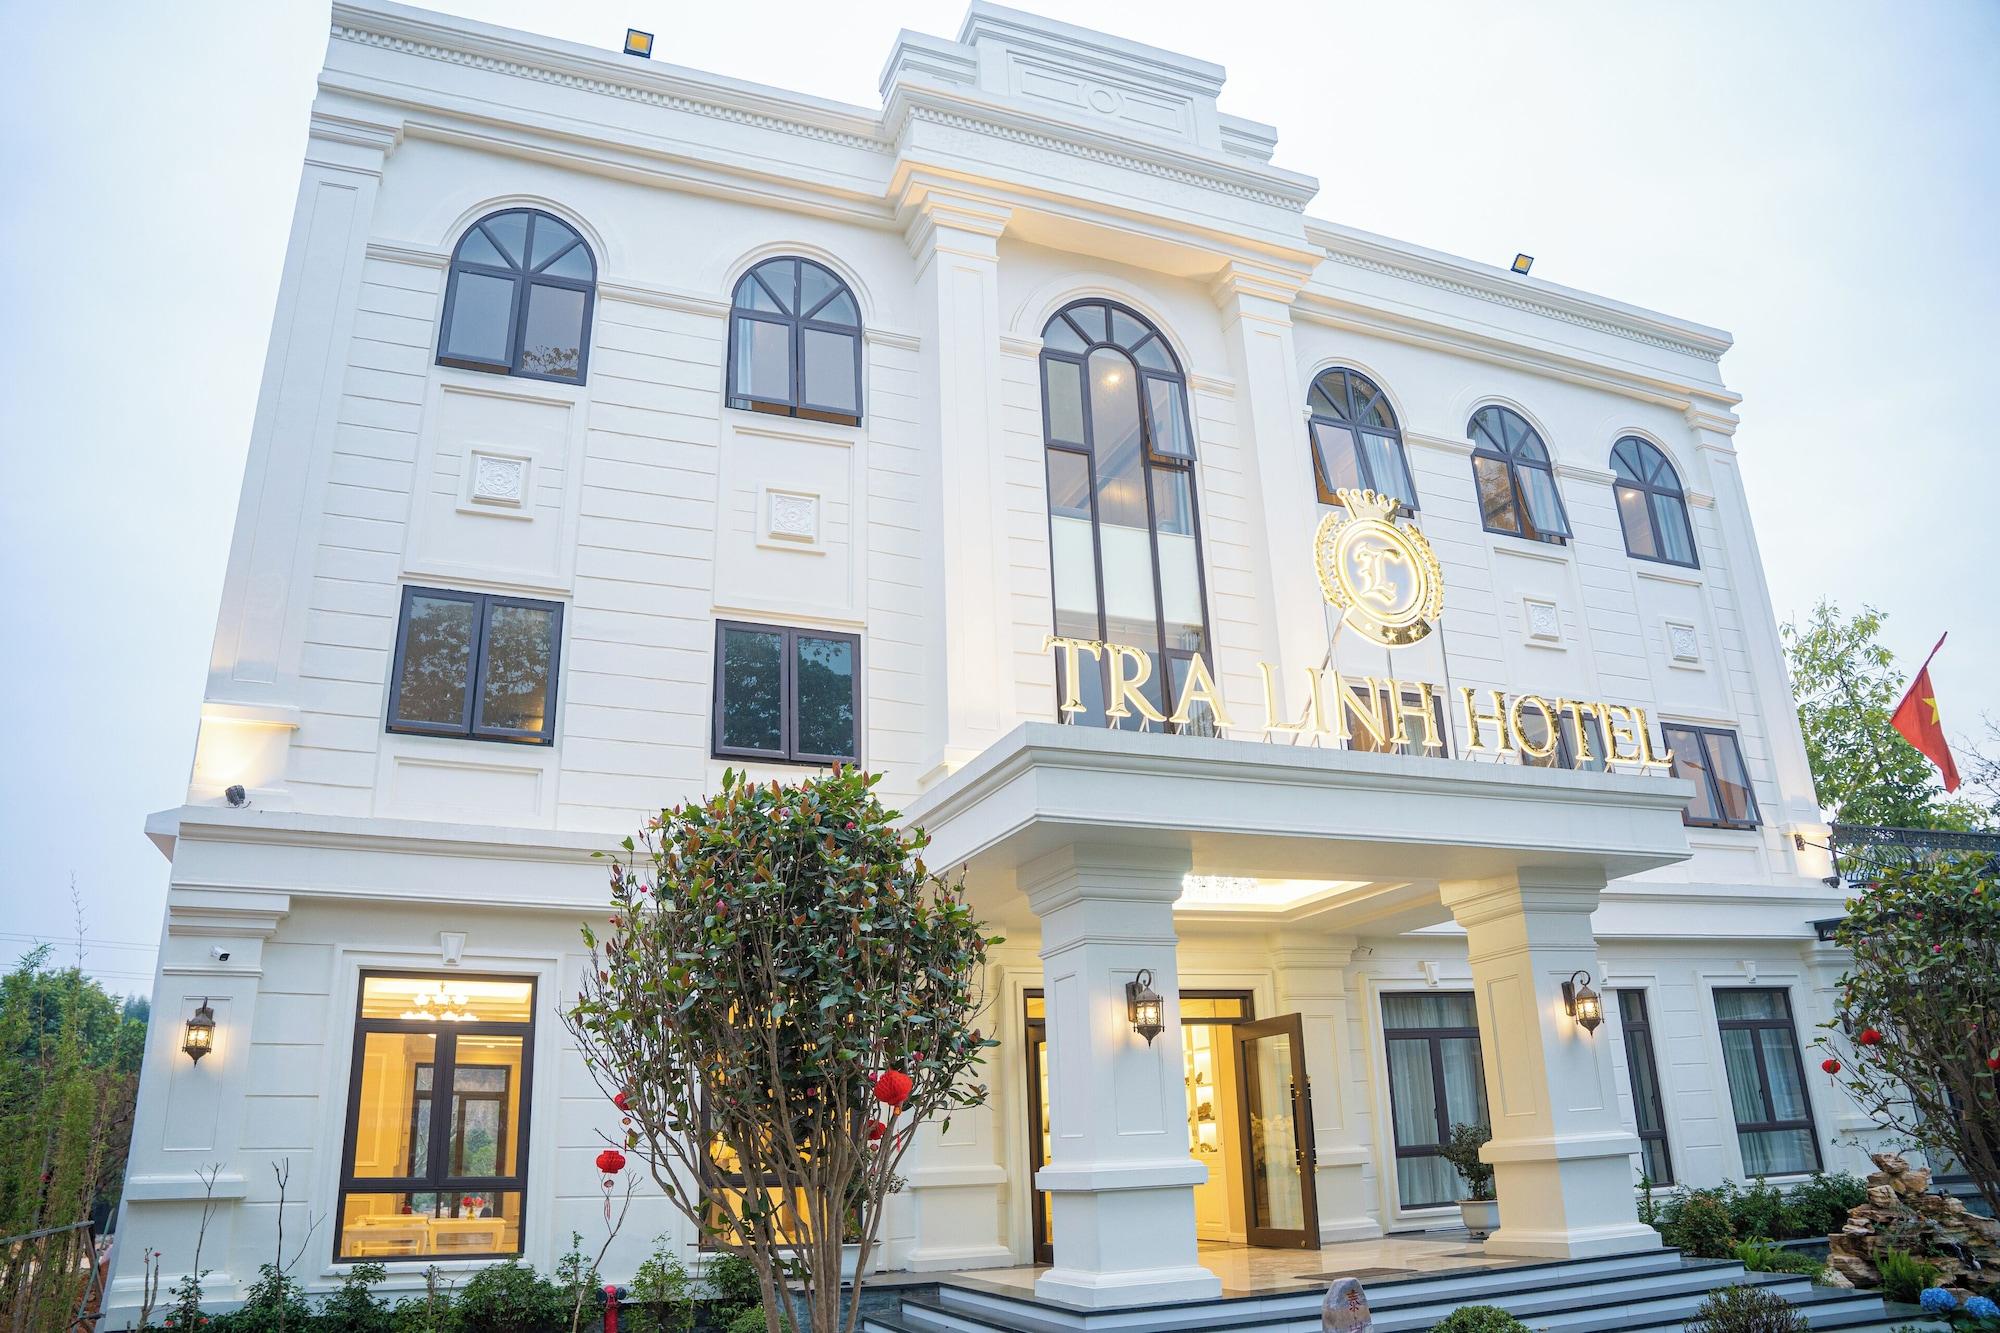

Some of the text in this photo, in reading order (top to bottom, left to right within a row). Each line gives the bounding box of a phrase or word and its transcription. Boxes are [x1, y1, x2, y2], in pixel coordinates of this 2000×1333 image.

[1042, 634, 1675, 767] TRA LINH HOTEL
